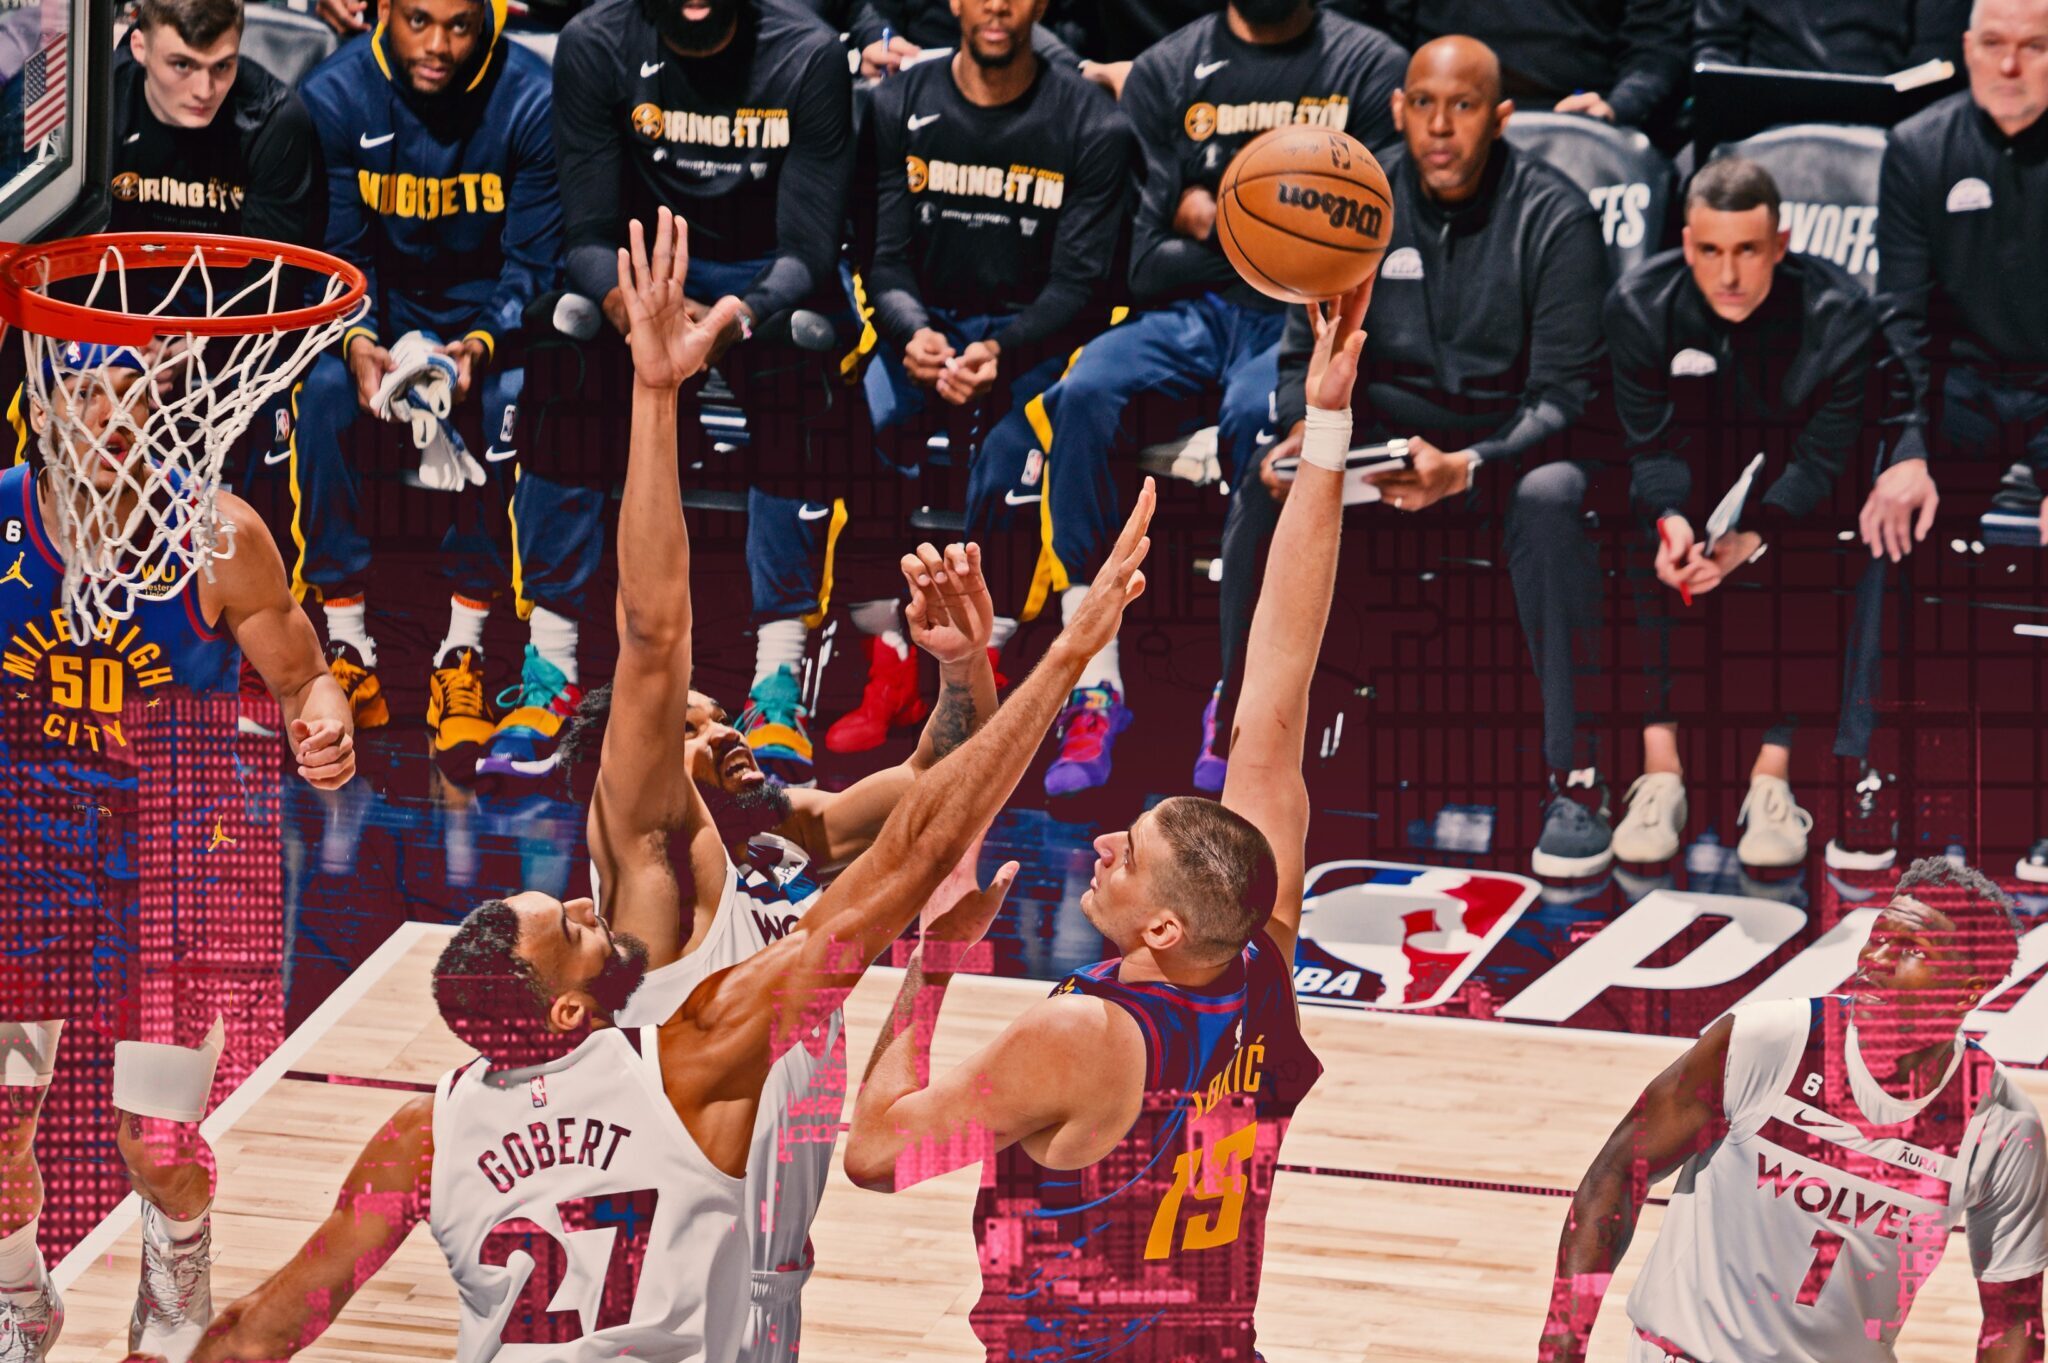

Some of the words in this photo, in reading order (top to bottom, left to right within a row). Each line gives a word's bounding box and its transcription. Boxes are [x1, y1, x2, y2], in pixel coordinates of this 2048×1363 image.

[1216, 101, 1294, 135] BRING
[358, 169, 505, 220] NUGGETS
[928, 160, 1004, 198] BRING
[1278, 182, 1383, 241] Wilson
[5, 520, 22, 543] 6
[3, 608, 74, 682] MILE
[94, 614, 174, 688] HIGH
[50, 655, 123, 713] 50
[43, 713, 127, 752] CITY
[1802, 1072, 1824, 1097] 6
[477, 1117, 632, 1194] GOBERT
[1143, 1121, 1258, 1260] 15
[478, 1188, 659, 1344] 27
[1795, 1229, 1846, 1307] 1
